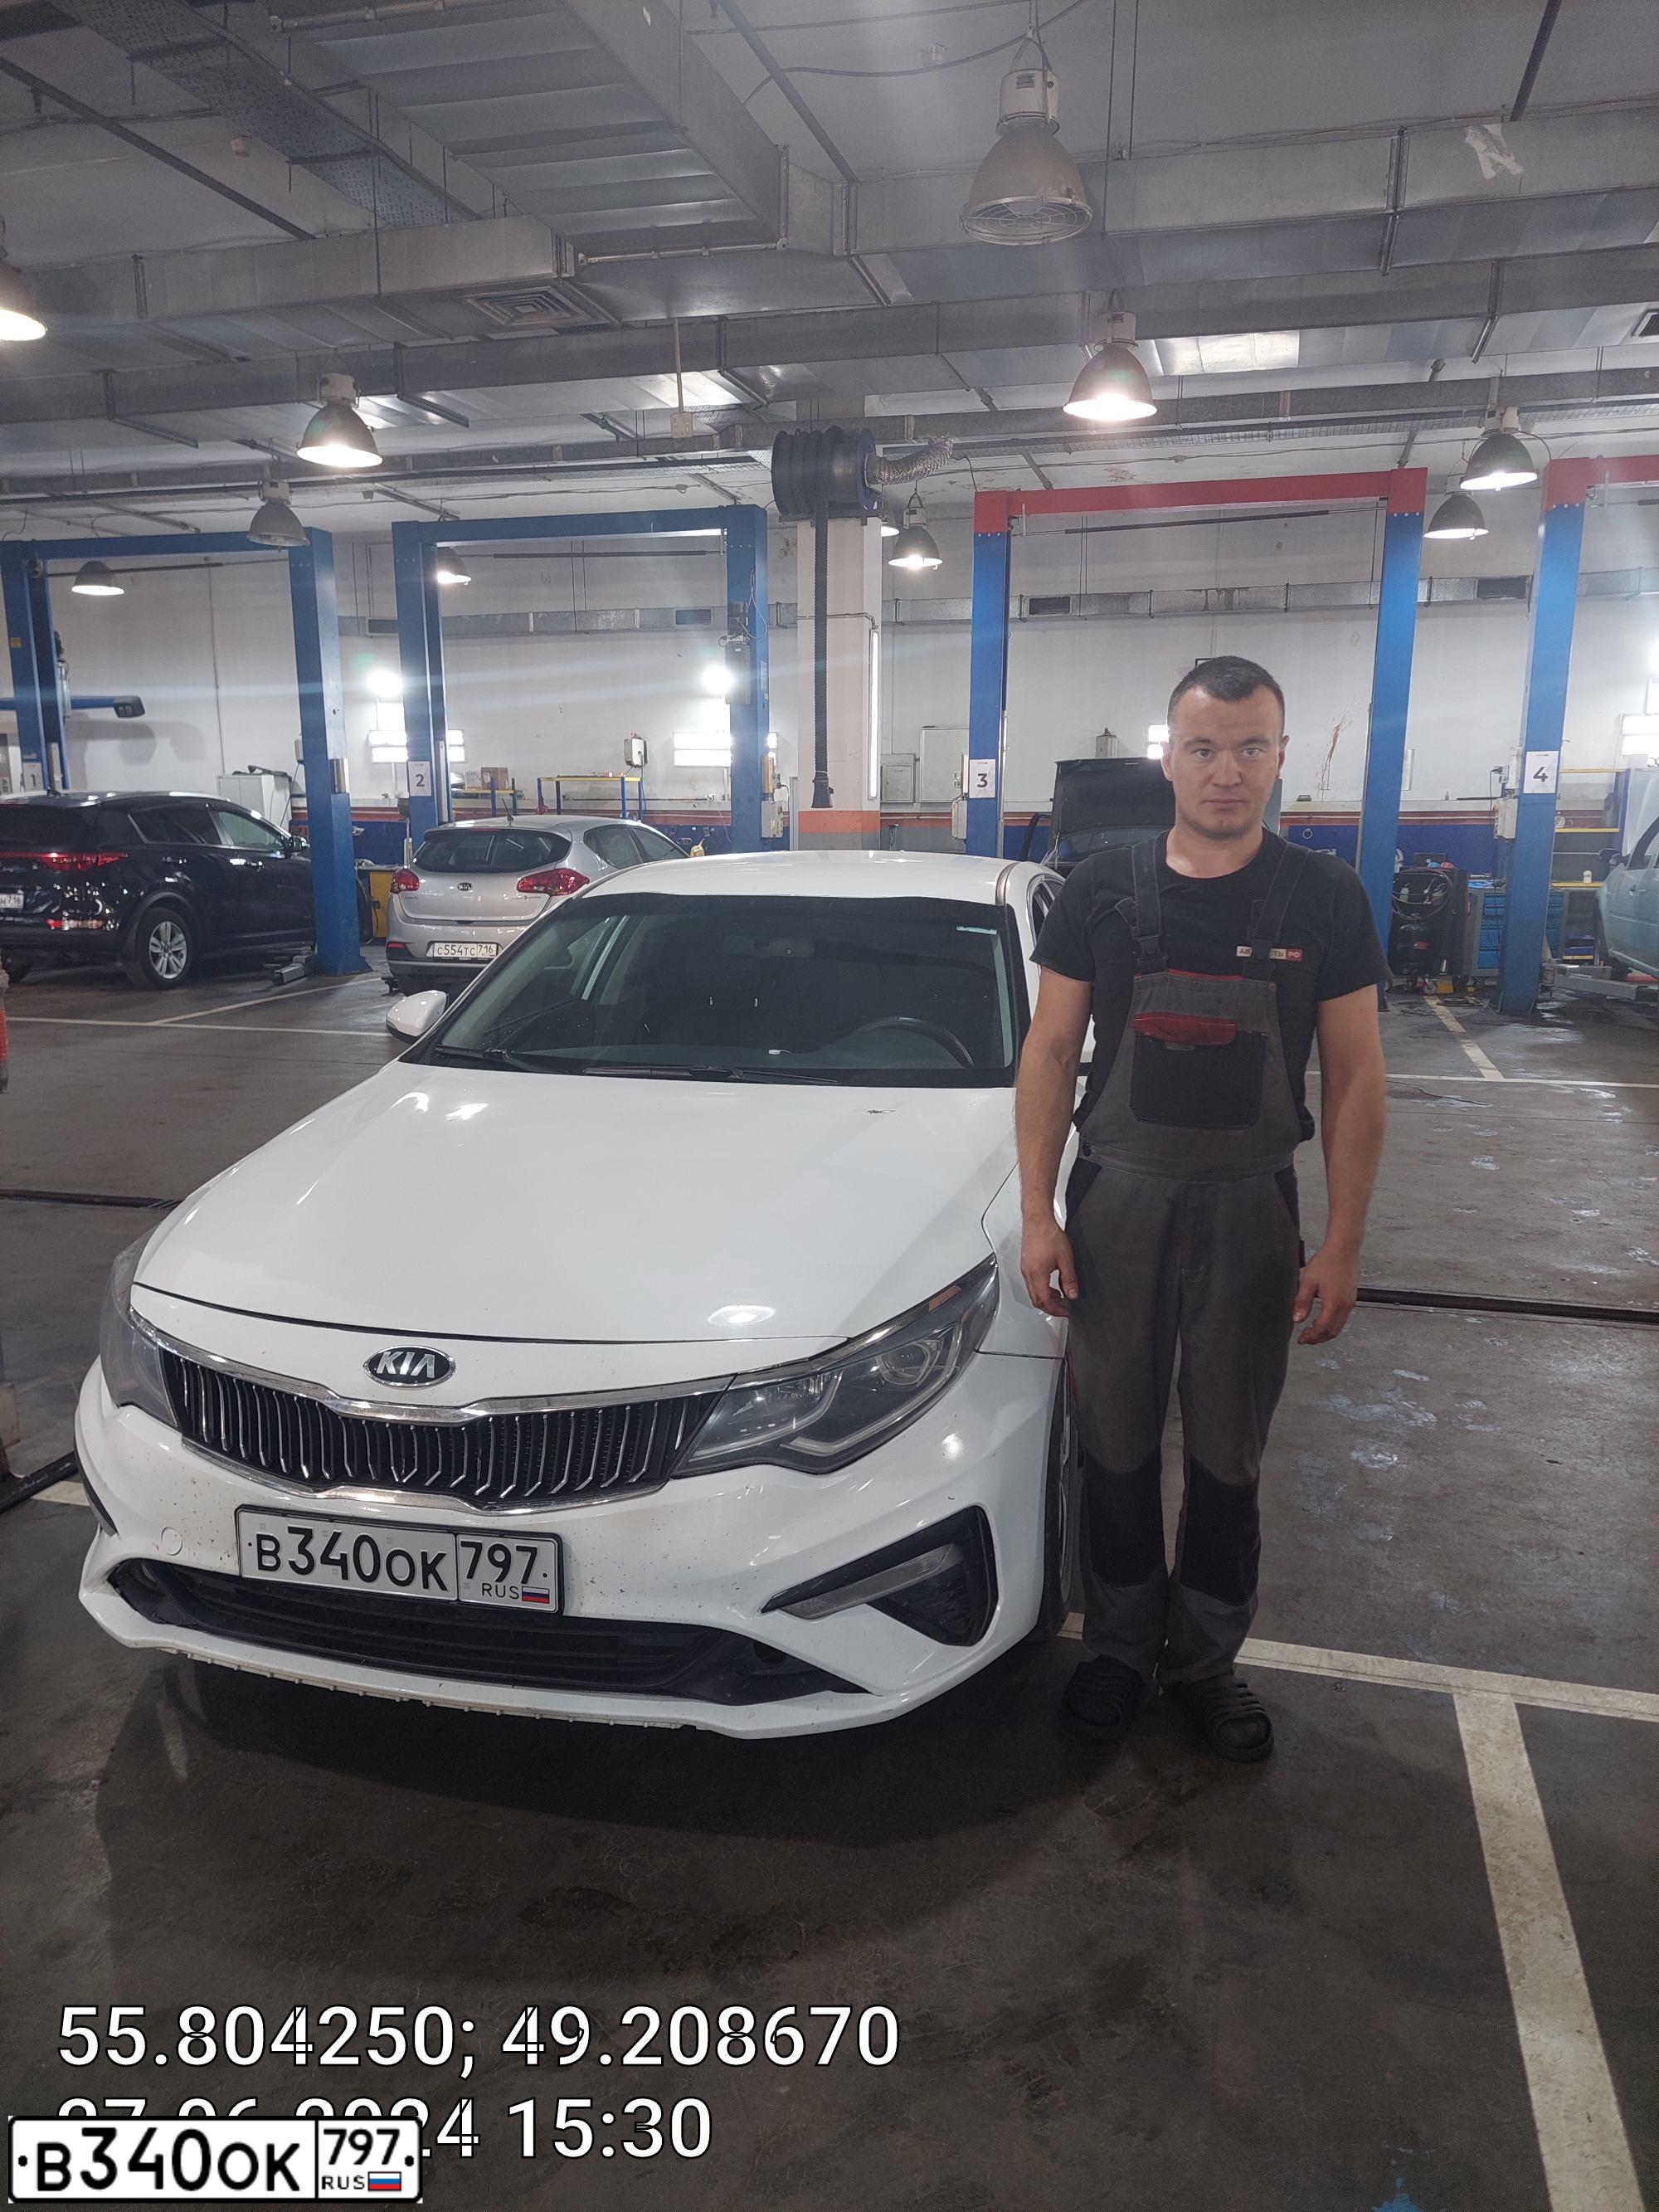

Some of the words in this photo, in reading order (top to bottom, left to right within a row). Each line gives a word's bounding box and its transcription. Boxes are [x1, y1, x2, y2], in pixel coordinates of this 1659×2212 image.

[415, 773, 426, 787] 2
[976, 772, 988, 788] 3
[1532, 766, 1549, 782] 4
[376, 1351, 435, 1378] KIA
[256, 1525, 448, 1591] В340ОК
[460, 1540, 538, 1585] 797
[481, 1582, 520, 1599] RUS
